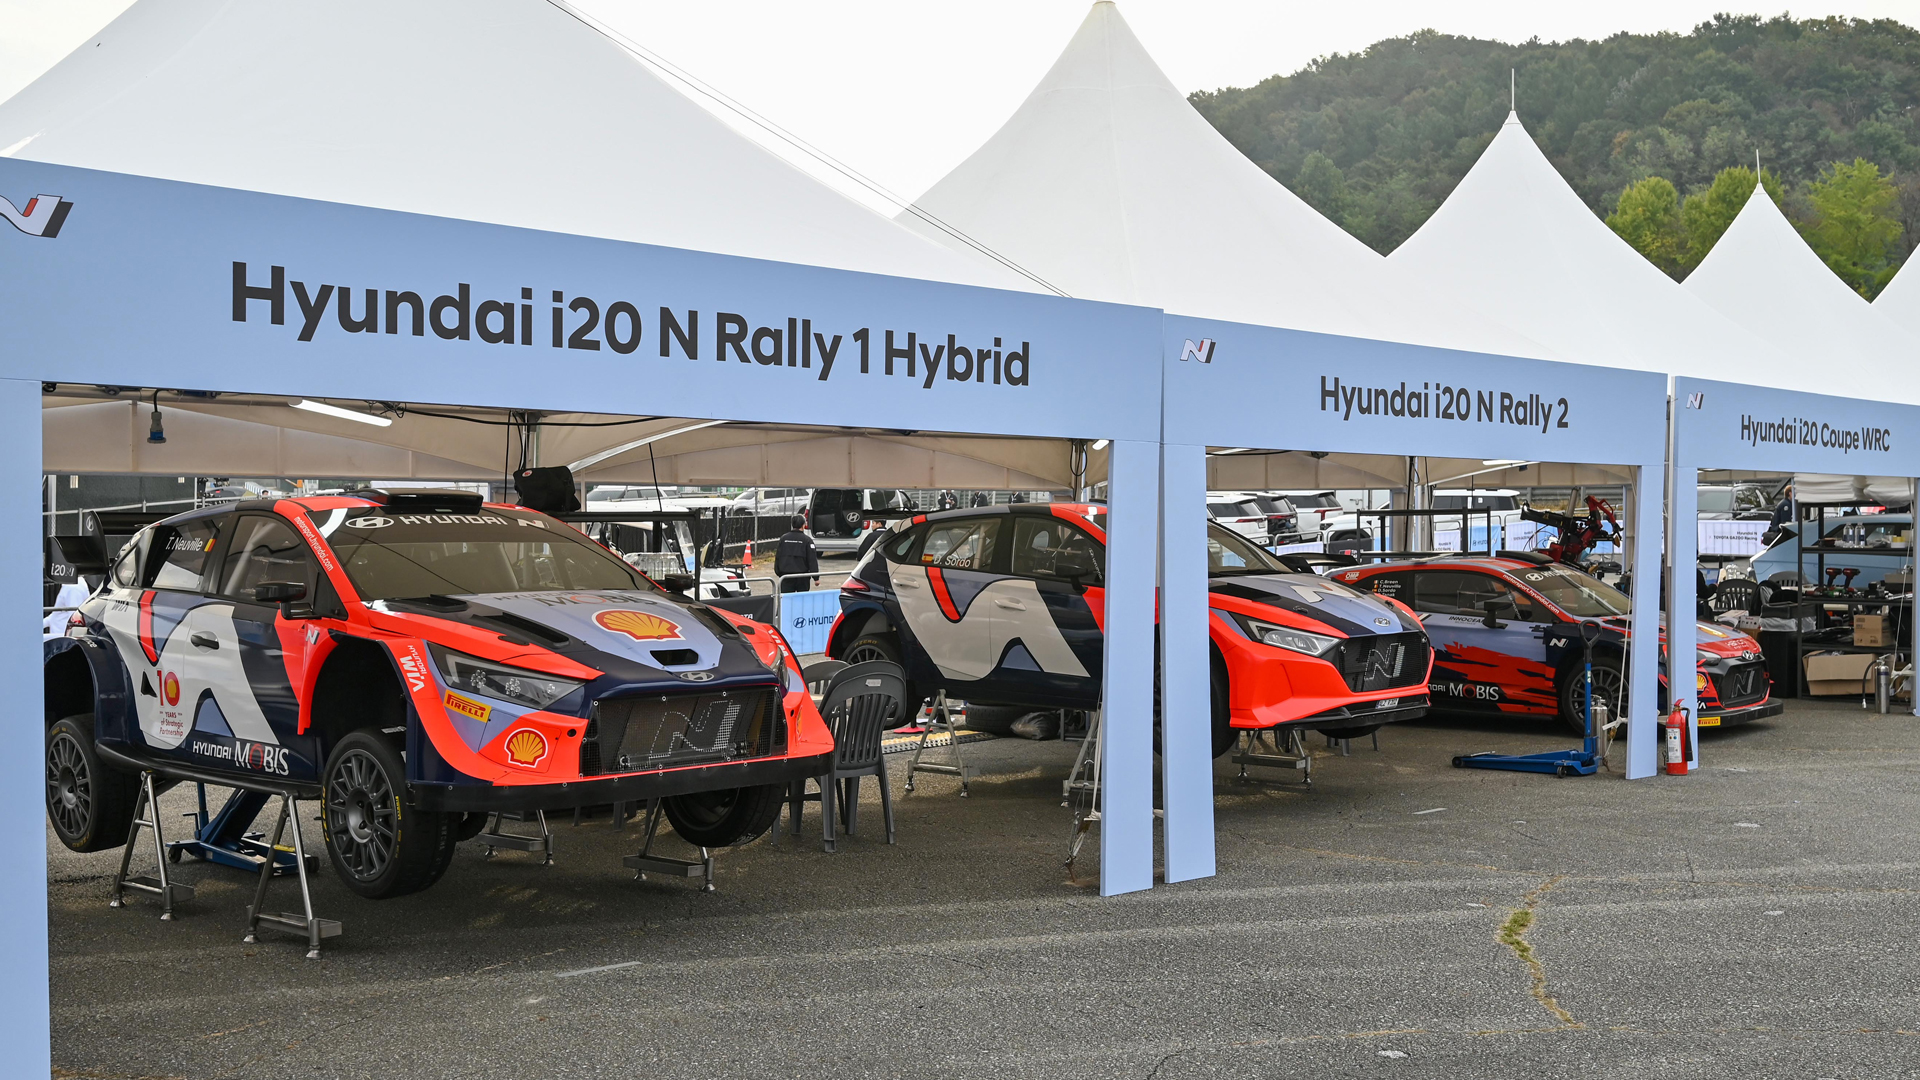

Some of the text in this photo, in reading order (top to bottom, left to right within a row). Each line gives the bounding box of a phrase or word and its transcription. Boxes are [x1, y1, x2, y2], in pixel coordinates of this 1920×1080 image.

[232, 261, 1030, 389] Hyundai i20 N Rally 1 Hybrid
[1320, 376, 1569, 433] Hyundai i20 N Rally 2
[1741, 414, 1891, 454] Hyundai i20 Coupe WRC
[399, 515, 508, 525] HYUNDAI
[172, 537, 204, 552] Neuville
[293, 516, 334, 572] motorsport.hyundai.com
[51, 563, 66, 577] i20
[933, 554, 971, 568] D. Sordo
[535, 594, 658, 607] MOBIS
[1502, 574, 1560, 615] motorsport.hyundai.com
[808, 616, 836, 627] HYUND
[407, 645, 428, 675] HYUNDAI
[1449, 682, 1500, 701] MOBIS
[165, 711, 178, 719] YEARS
[446, 693, 487, 718] PIRELLI
[1698, 718, 1720, 726] PIRELLI
[192, 740, 289, 776] HYUNDAI MOBIS
